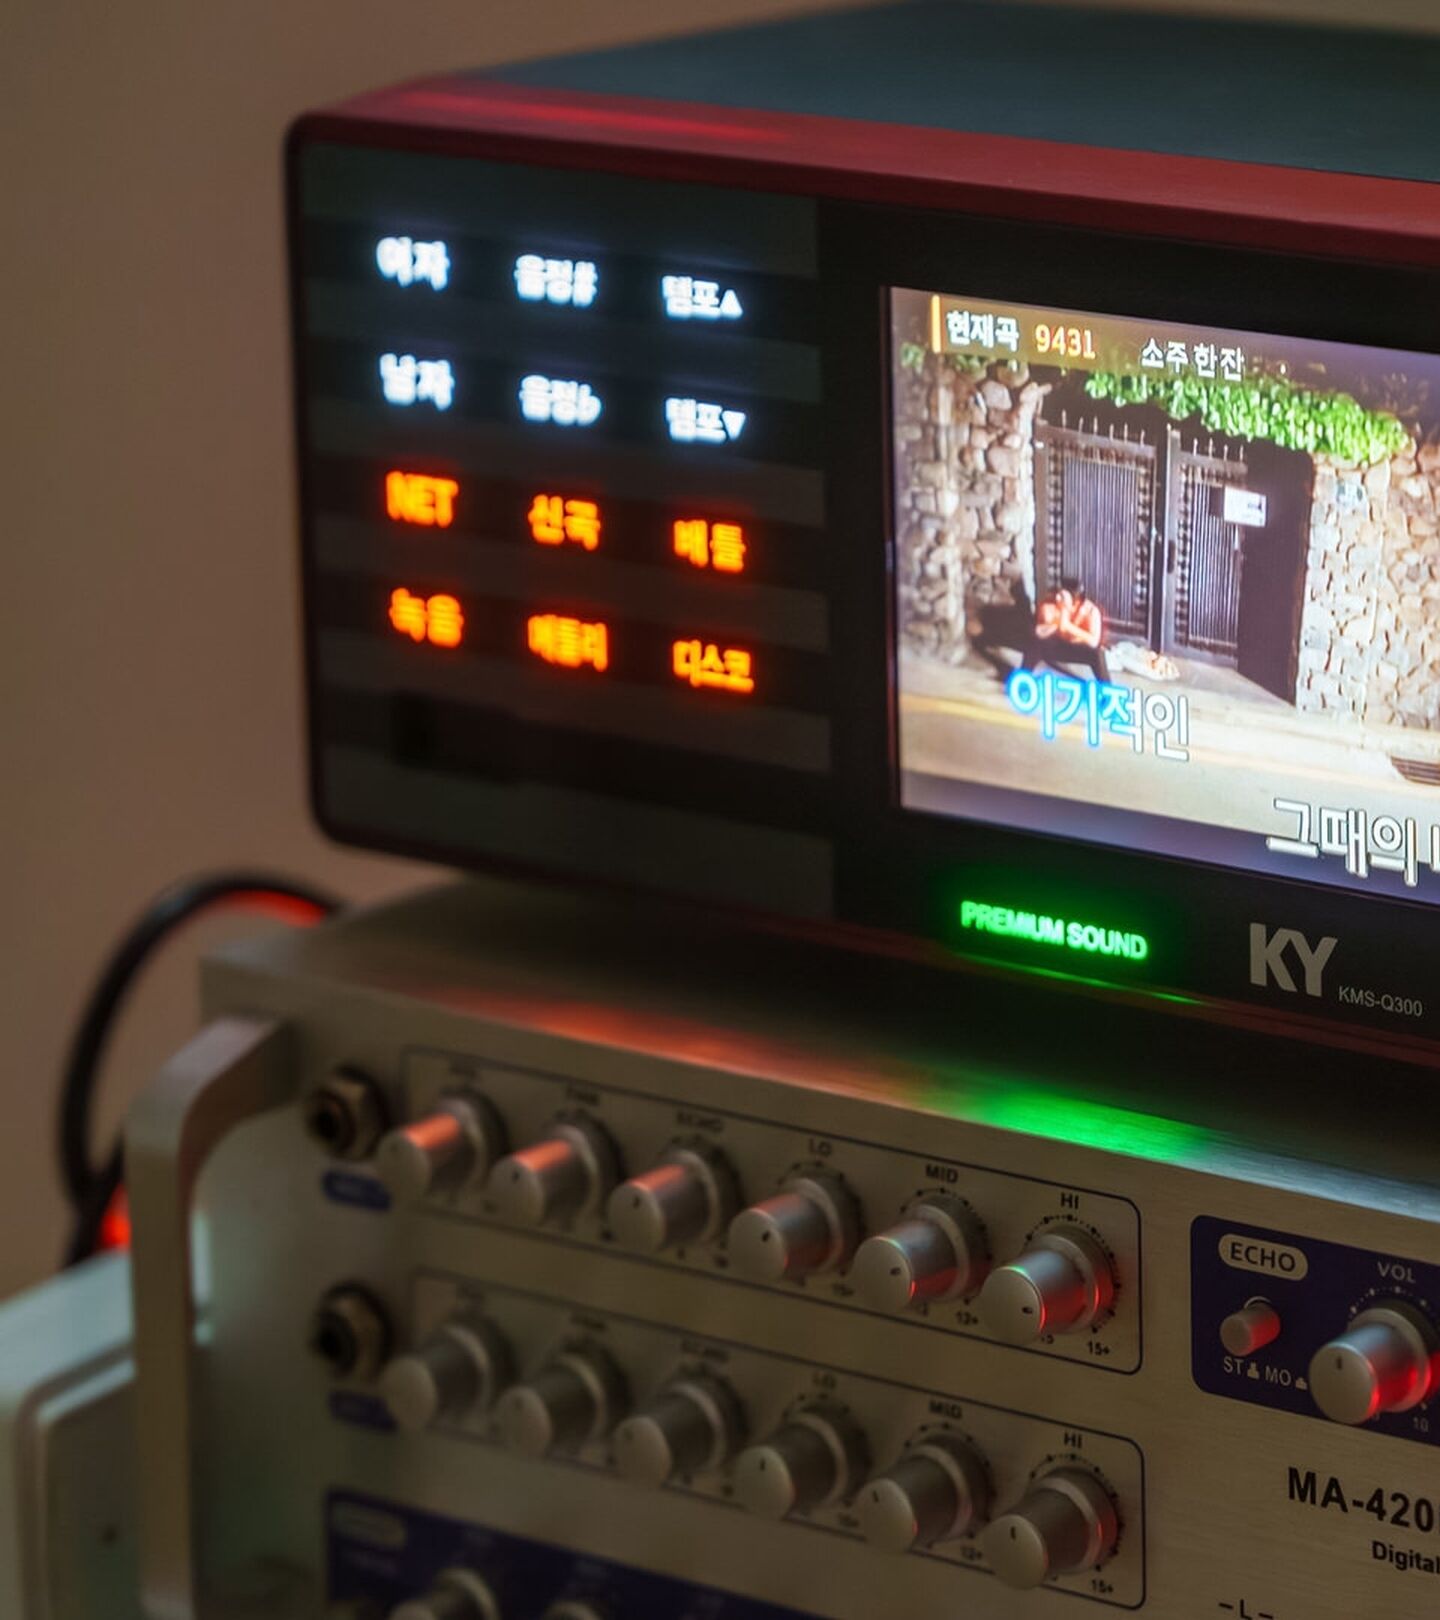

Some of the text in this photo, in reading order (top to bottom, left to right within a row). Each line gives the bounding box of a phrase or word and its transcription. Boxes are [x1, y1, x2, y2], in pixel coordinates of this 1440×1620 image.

[946, 310, 1096, 359] 현재곡 9431
[386, 471, 459, 528] NET
[528, 494, 601, 550] 신곡
[673, 640, 754, 693] 디스코
[1009, 671, 1189, 761] 이기적인
[1265, 797, 1418, 887] 그때의
[962, 901, 1148, 960] PREMIUM SOUND
[1250, 922, 1338, 997] KY
[1338, 985, 1423, 1017] KMS-Q300
[925, 1164, 959, 1184] MID
[1060, 1192, 1080, 1210] HI
[1229, 1241, 1297, 1273] ECHO
[1377, 1261, 1417, 1285] VOL
[1222, 1354, 1292, 1388] ST MO
[1063, 1431, 1083, 1450] HI
[1371, 1540, 1440, 1572] Digital
